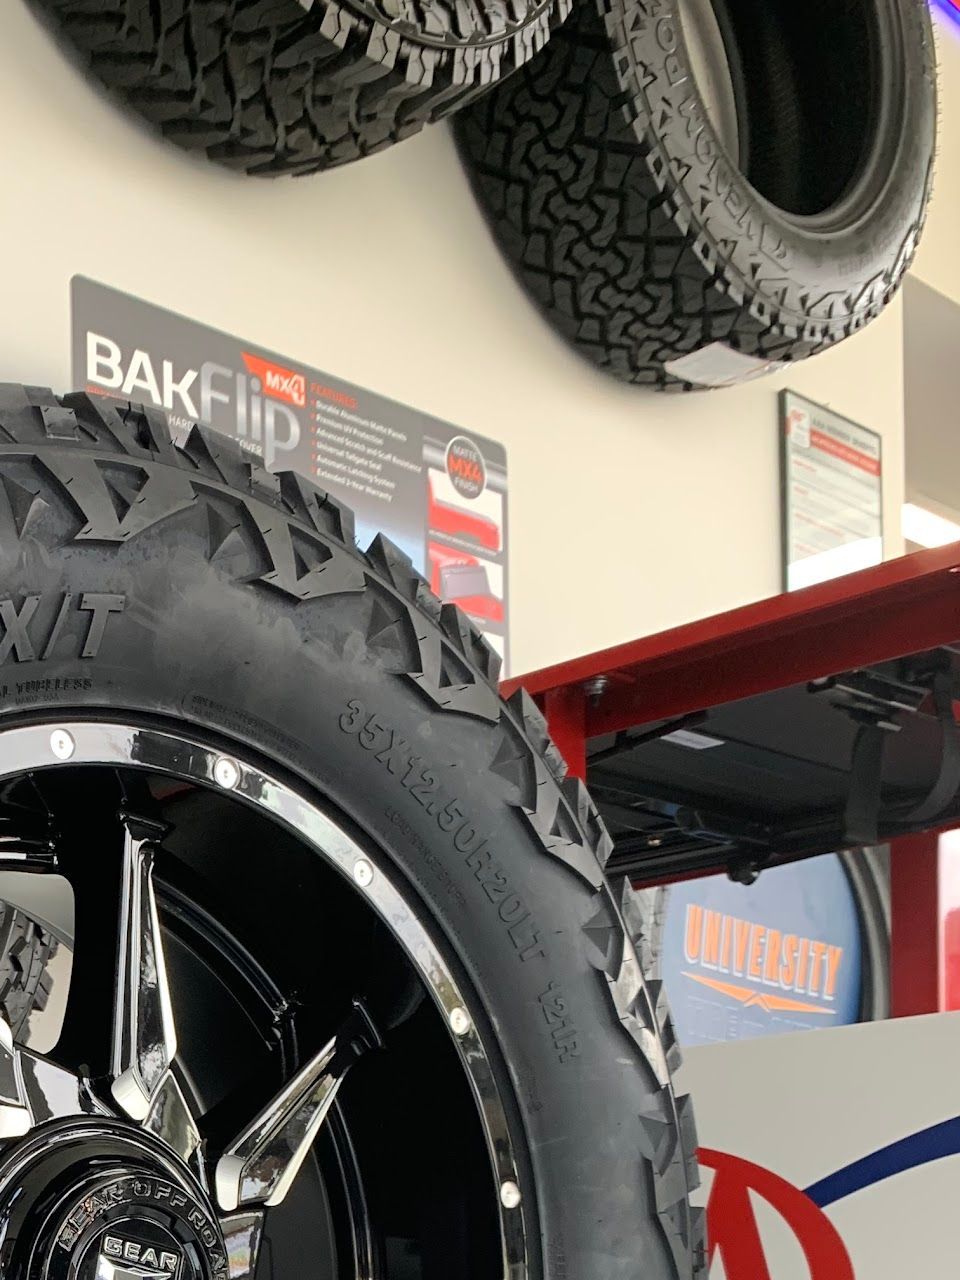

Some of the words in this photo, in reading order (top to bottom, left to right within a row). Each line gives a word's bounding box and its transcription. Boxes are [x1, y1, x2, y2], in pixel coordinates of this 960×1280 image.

[265, 369, 305, 407] MX4
[449, 454, 483, 482] MX4
[684, 903, 843, 1001] UNIVERSITY
[133, 1181, 189, 1208] OFF
[103, 1235, 179, 1273] GEAR
